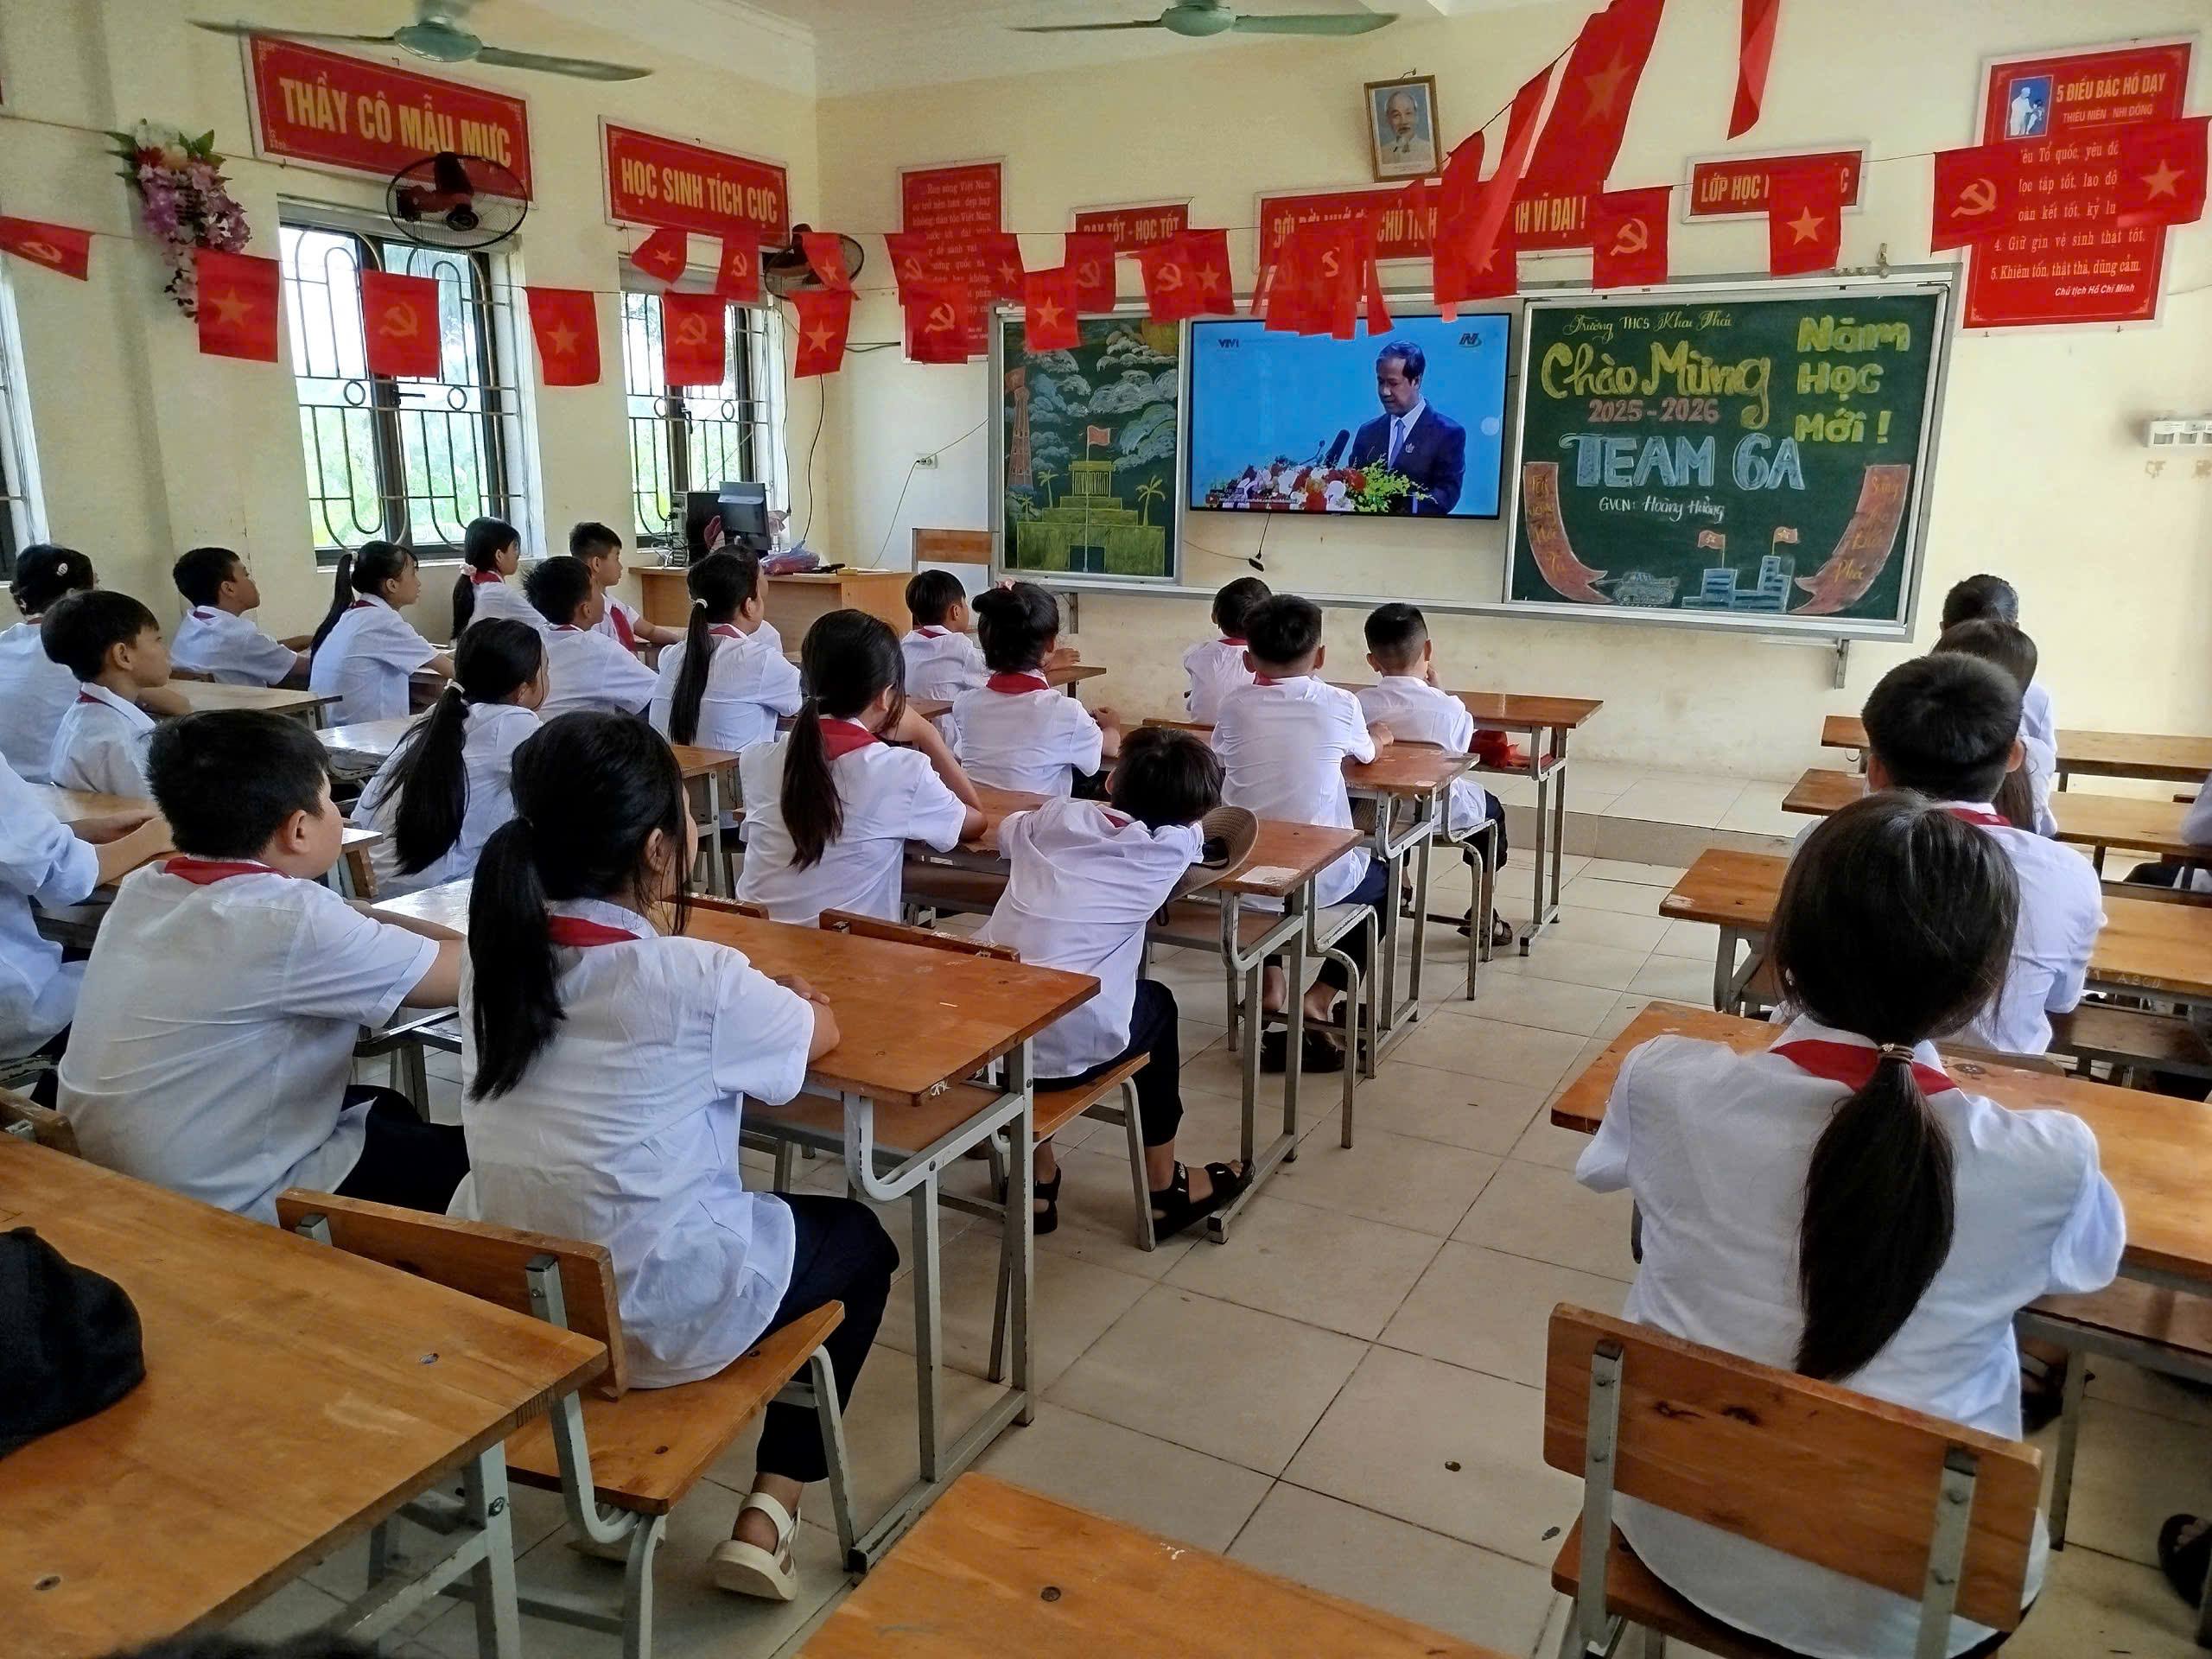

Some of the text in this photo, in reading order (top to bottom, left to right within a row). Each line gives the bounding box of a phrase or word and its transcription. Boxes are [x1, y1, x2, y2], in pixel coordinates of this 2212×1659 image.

[2056, 70, 2166, 103] 5 ĐIỀU BÁC HỒ DẠY
[278, 72, 346, 134] THẦY
[357, 91, 391, 143] CÔ
[398, 94, 455, 153] MẪU
[2113, 106, 2126, 118] NHI
[622, 157, 777, 228] HỌC SINH TÍCH CỰC
[1700, 173, 1728, 202] LỚP
[1731, 174, 1761, 205] HỌC
[2082, 173, 2099, 188] lao
[1535, 192, 1549, 232] VĨ
[1551, 196, 1577, 238] ĐẠI
[1135, 219, 1157, 245] HỌC
[2072, 231, 2094, 246] sinh
[2115, 283, 2135, 293] Minh
[1619, 315, 1649, 329] THCS
[1541, 340, 1771, 430] Chào Mừng
[1558, 433, 1715, 487] TEAM
[1732, 432, 1805, 491] 6A
[1599, 496, 1636, 512] GVCN:
